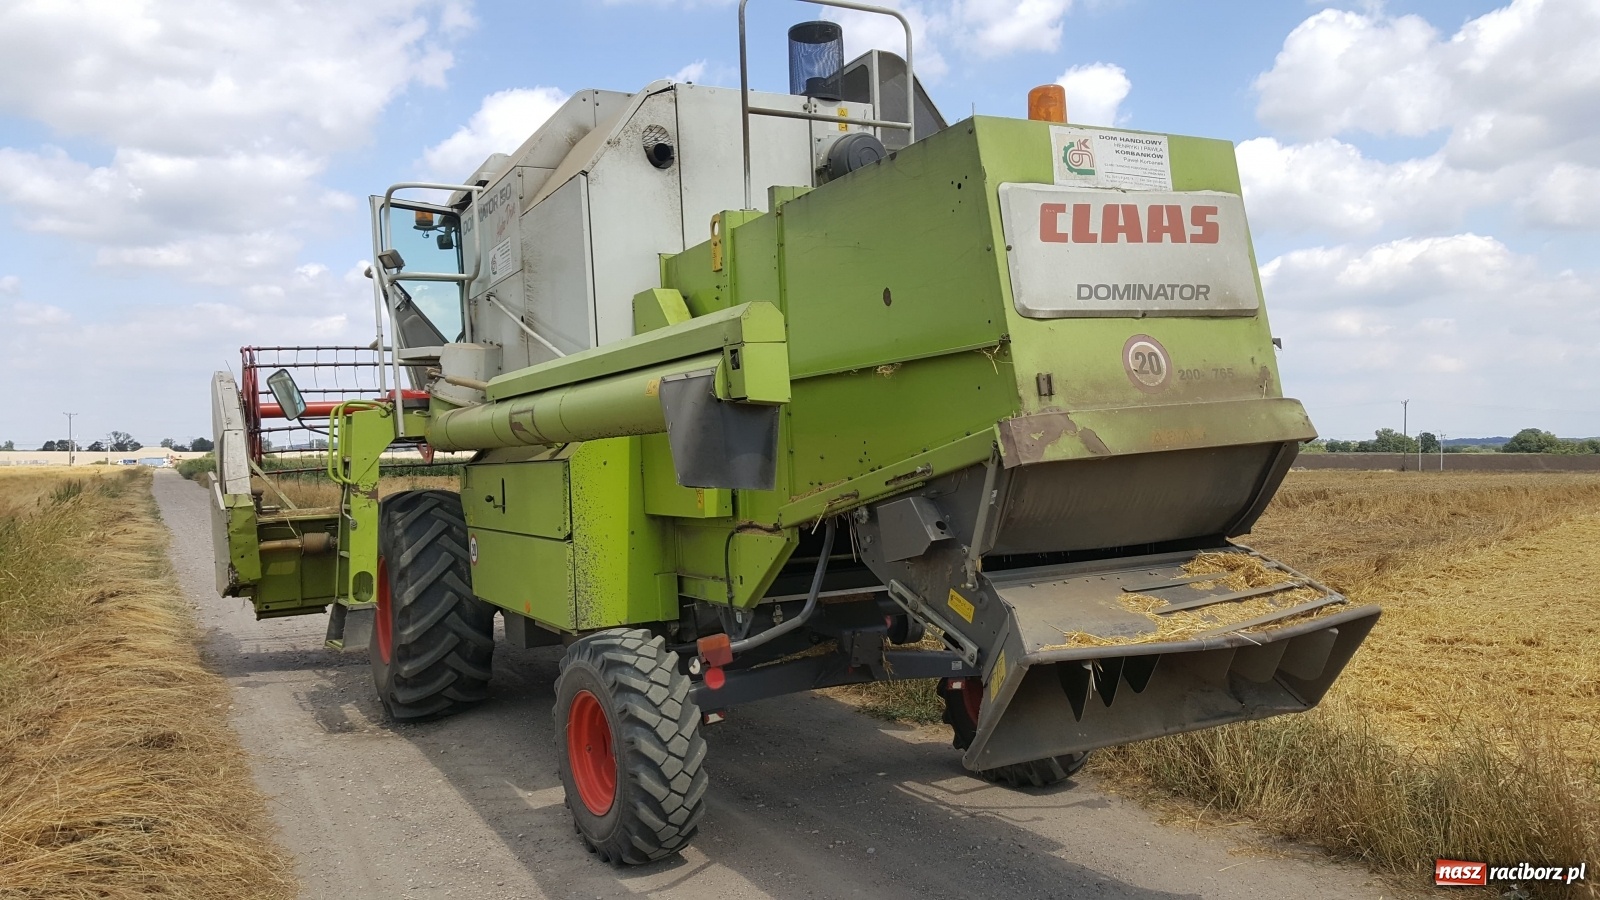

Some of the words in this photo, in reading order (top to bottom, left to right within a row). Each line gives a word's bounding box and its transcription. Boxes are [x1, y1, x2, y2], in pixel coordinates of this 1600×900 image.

[1119, 137, 1163, 146] HANDLOWY
[1115, 149, 1164, 159] KORBANKÓW
[500, 183, 512, 207] 150
[1039, 202, 1220, 244] CLAAS
[1076, 283, 1211, 301] DOMINATOR
[1135, 351, 1162, 375] 20
[1212, 367, 1234, 380] 765
